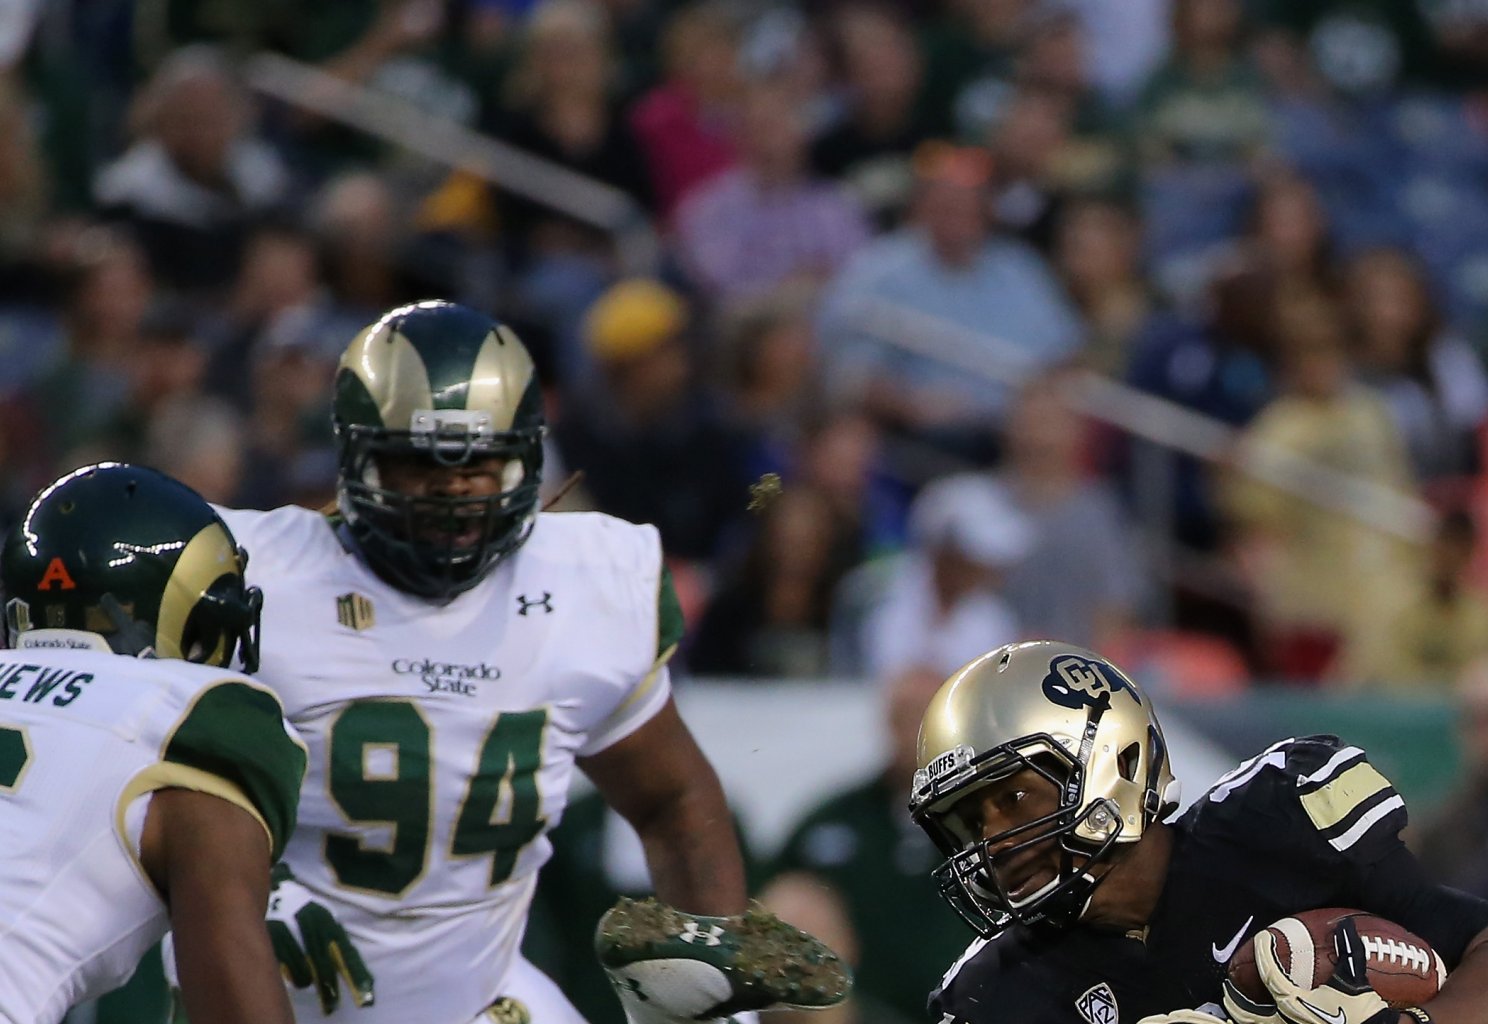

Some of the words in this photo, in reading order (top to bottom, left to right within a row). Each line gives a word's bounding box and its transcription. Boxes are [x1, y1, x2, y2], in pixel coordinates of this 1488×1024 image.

[37, 556, 76, 591] A
[24, 638, 66, 650] Colorado
[392, 657, 501, 681] Colorado
[0, 663, 95, 708] EWS
[421, 674, 477, 697] State
[928, 752, 955, 780] BUFFS
[323, 695, 552, 899] 94
